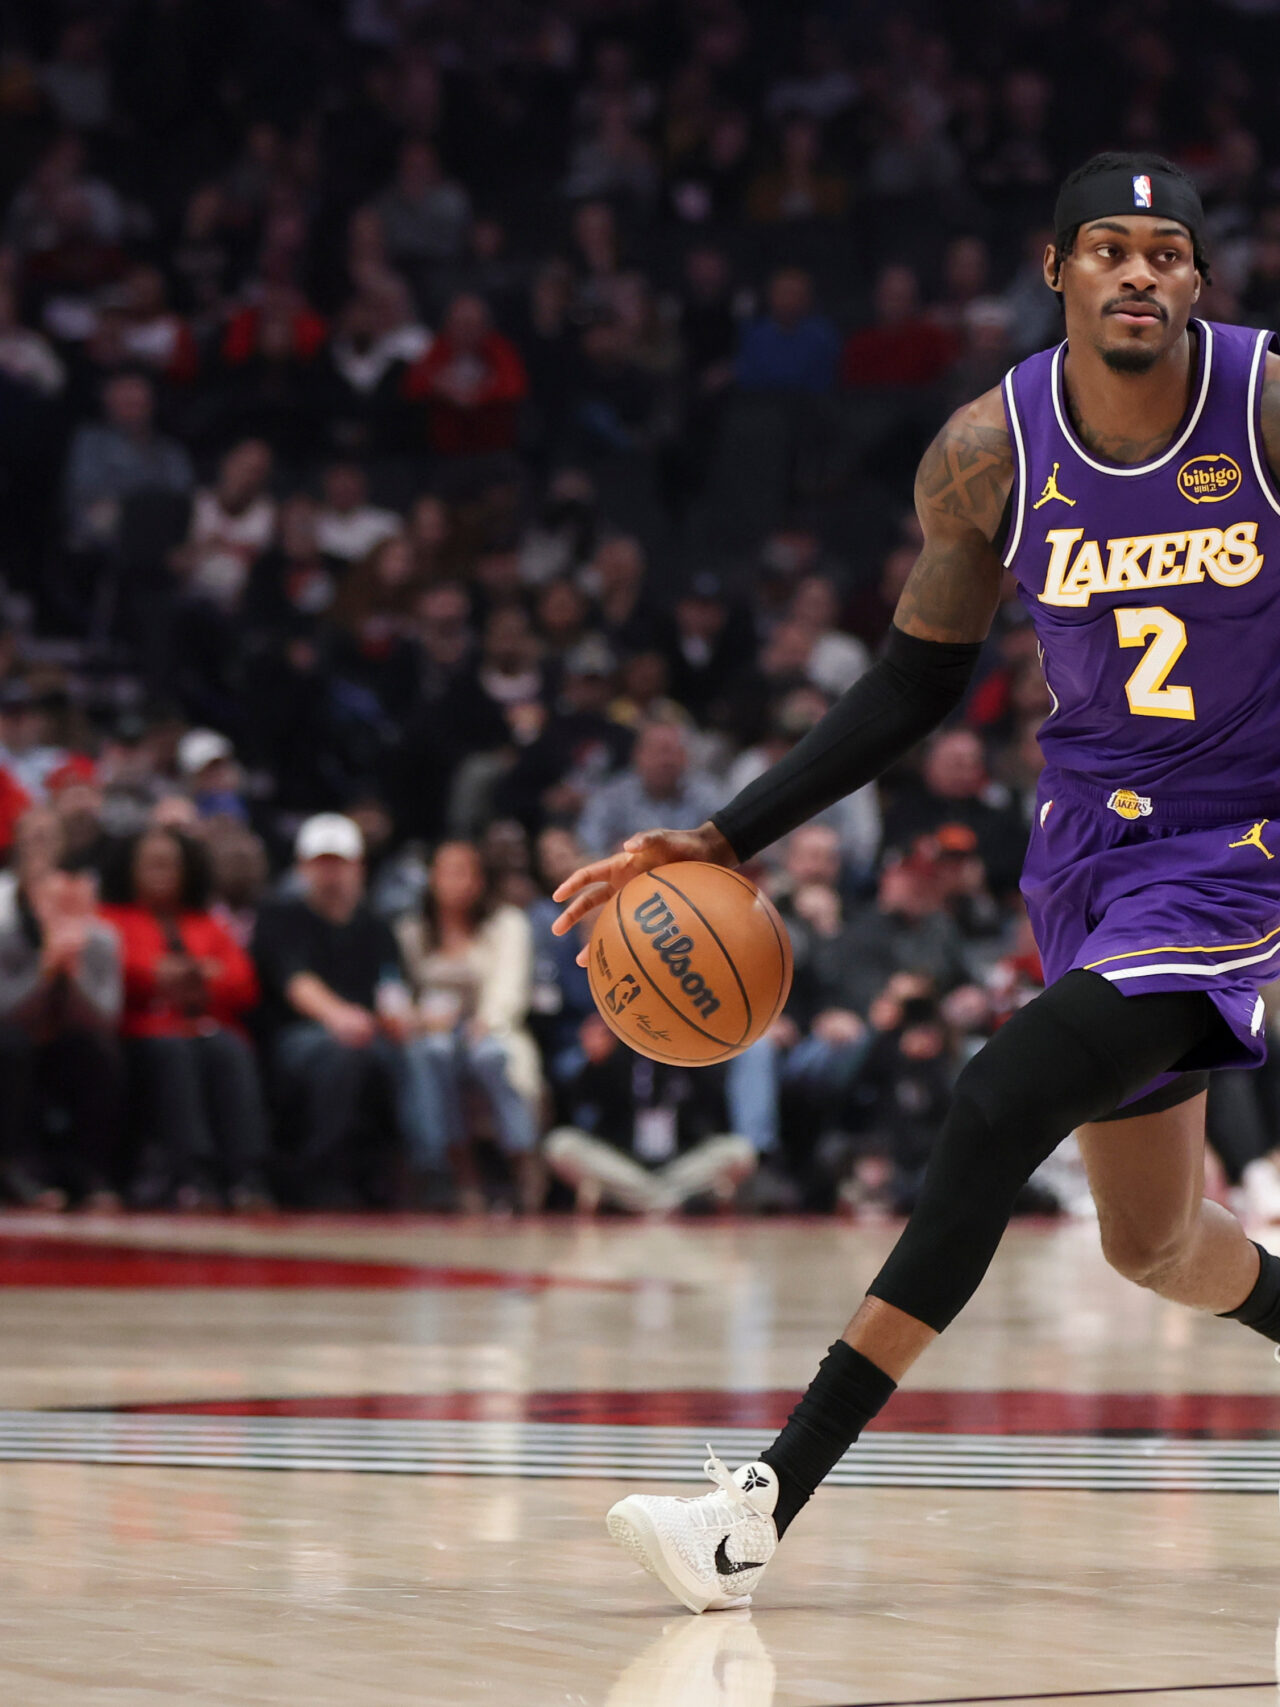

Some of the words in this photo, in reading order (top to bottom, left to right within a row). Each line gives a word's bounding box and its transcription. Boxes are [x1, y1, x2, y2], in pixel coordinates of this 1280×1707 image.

[1183, 467, 1237, 487] bibigo
[1194, 483, 1217, 493] 비비고
[1037, 522, 1264, 607] LAKERS
[1113, 606, 1195, 720] 2
[633, 891, 721, 1020] Wilson
